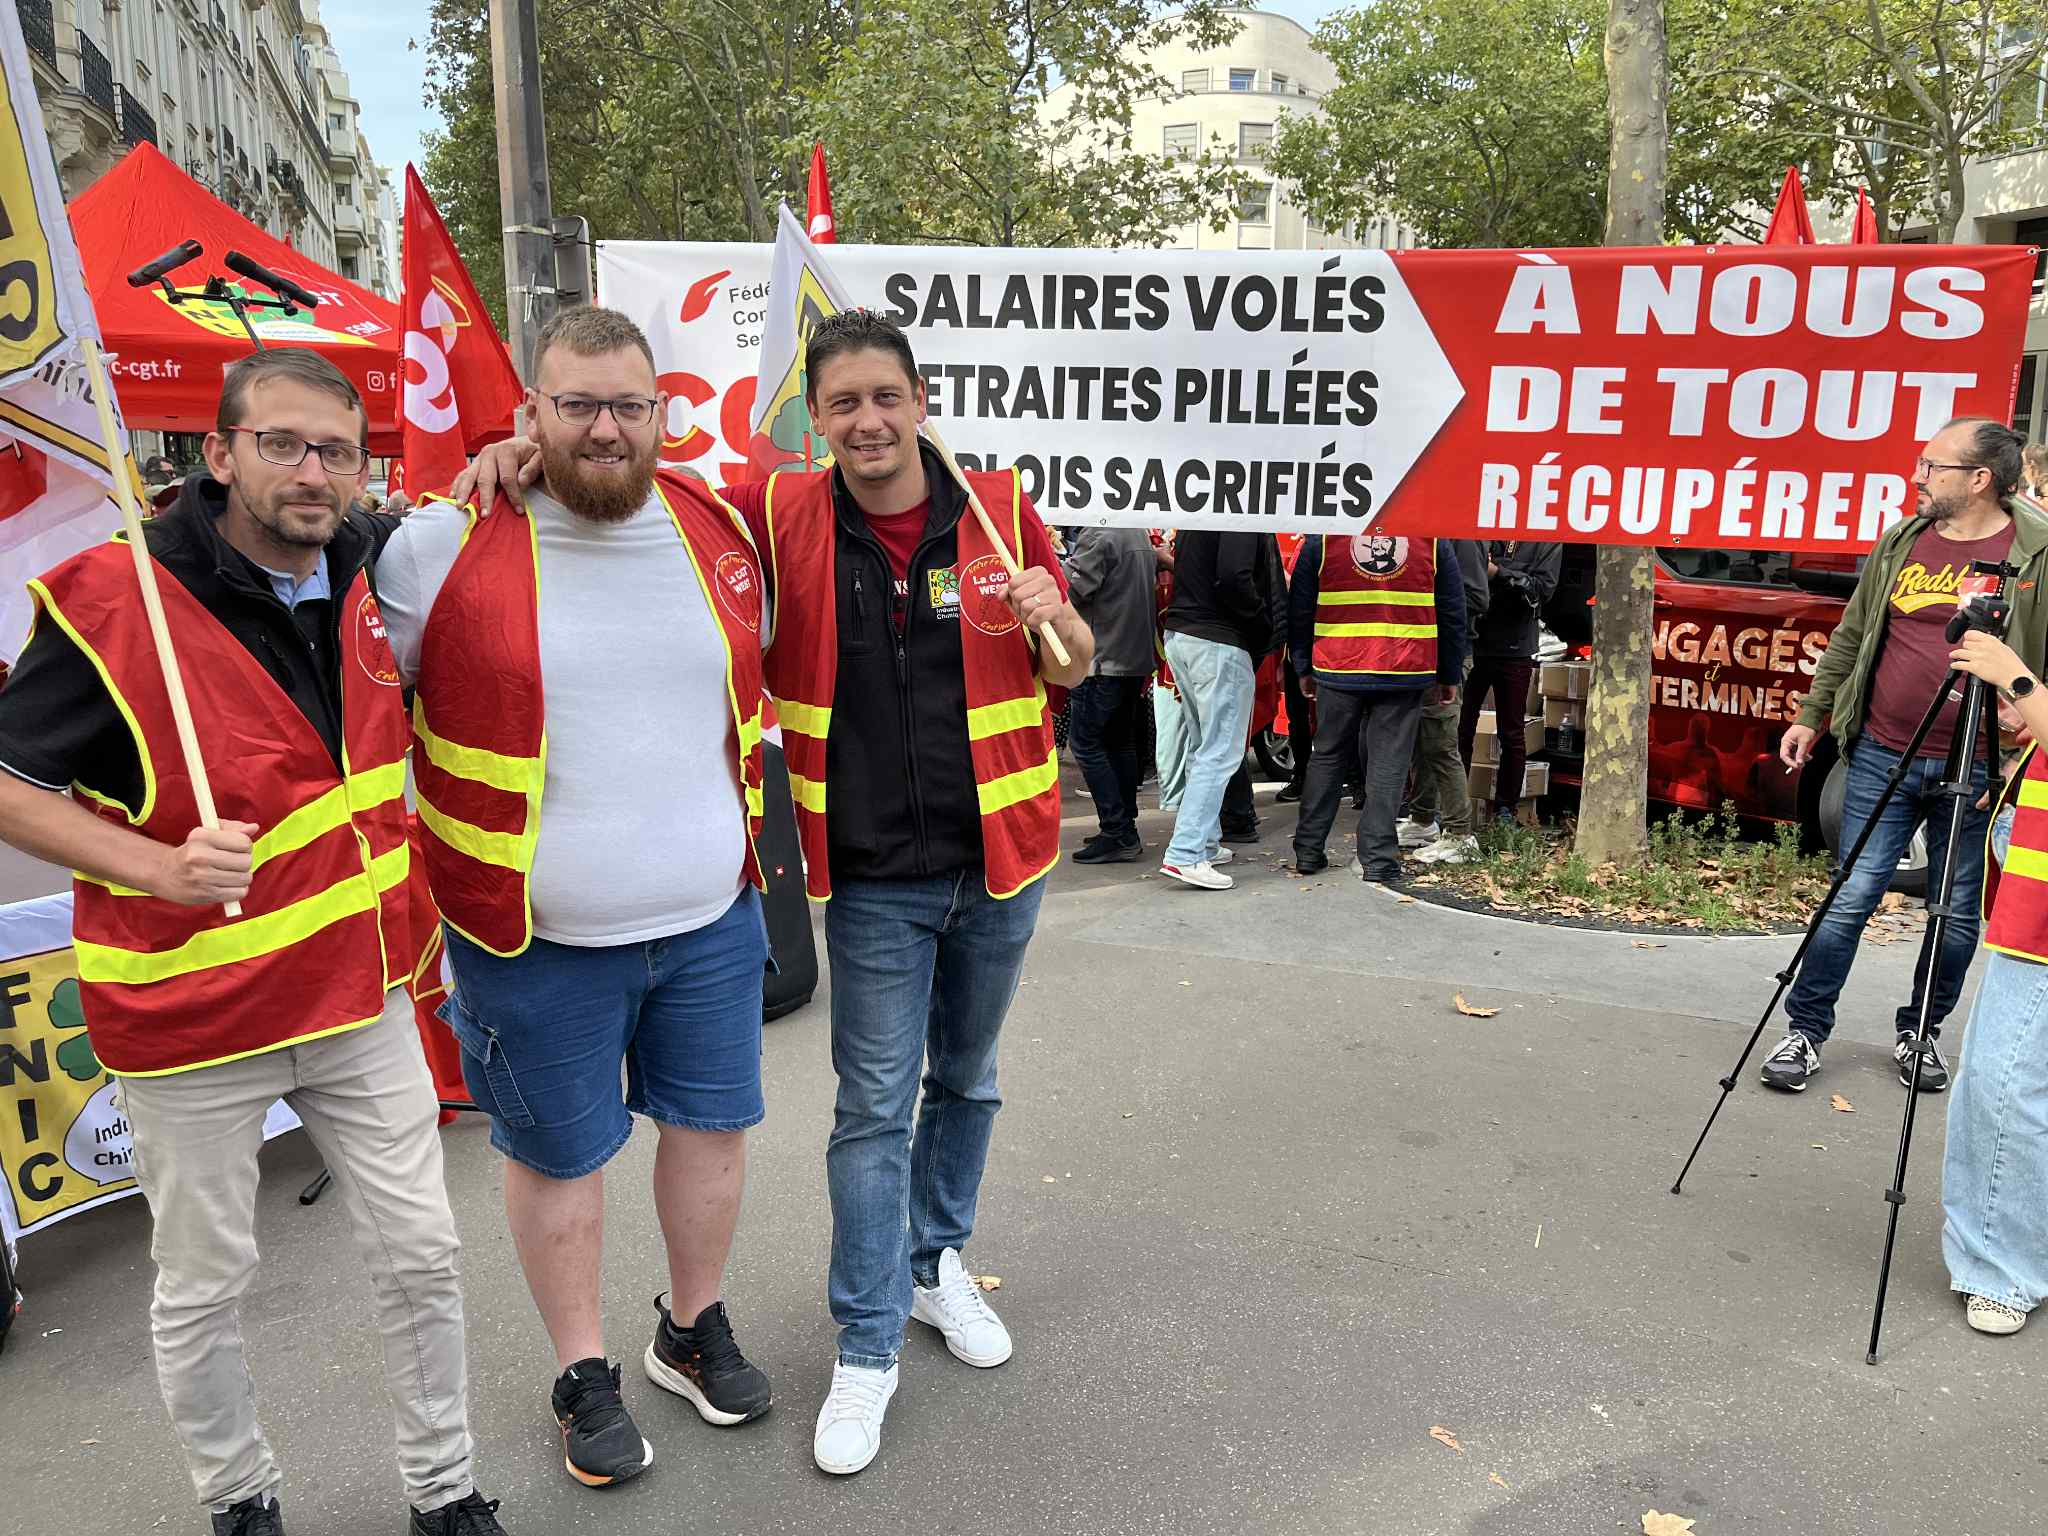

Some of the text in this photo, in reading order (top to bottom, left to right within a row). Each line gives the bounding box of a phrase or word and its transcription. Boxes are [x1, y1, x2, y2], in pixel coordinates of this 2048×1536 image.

[885, 256, 1386, 333] SALAIRES VOLÉS
[1495, 253, 1986, 340] À NOUS
[110, 359, 182, 380] c-cgt.fr
[918, 348, 1379, 427] ETRAITES PILLÉES
[1486, 366, 1627, 434] DE
[1656, 368, 1978, 442] TOUT
[1103, 441, 1373, 518] SACRIFIÉS
[1477, 452, 1907, 542] RÉCUPÉRER
[973, 575, 987, 585] La
[366, 616, 379, 626] La
[1652, 618, 1828, 676] NGAGÉS
[1650, 680, 1803, 723] TERMINÉS
[1704, 661, 1721, 682] et
